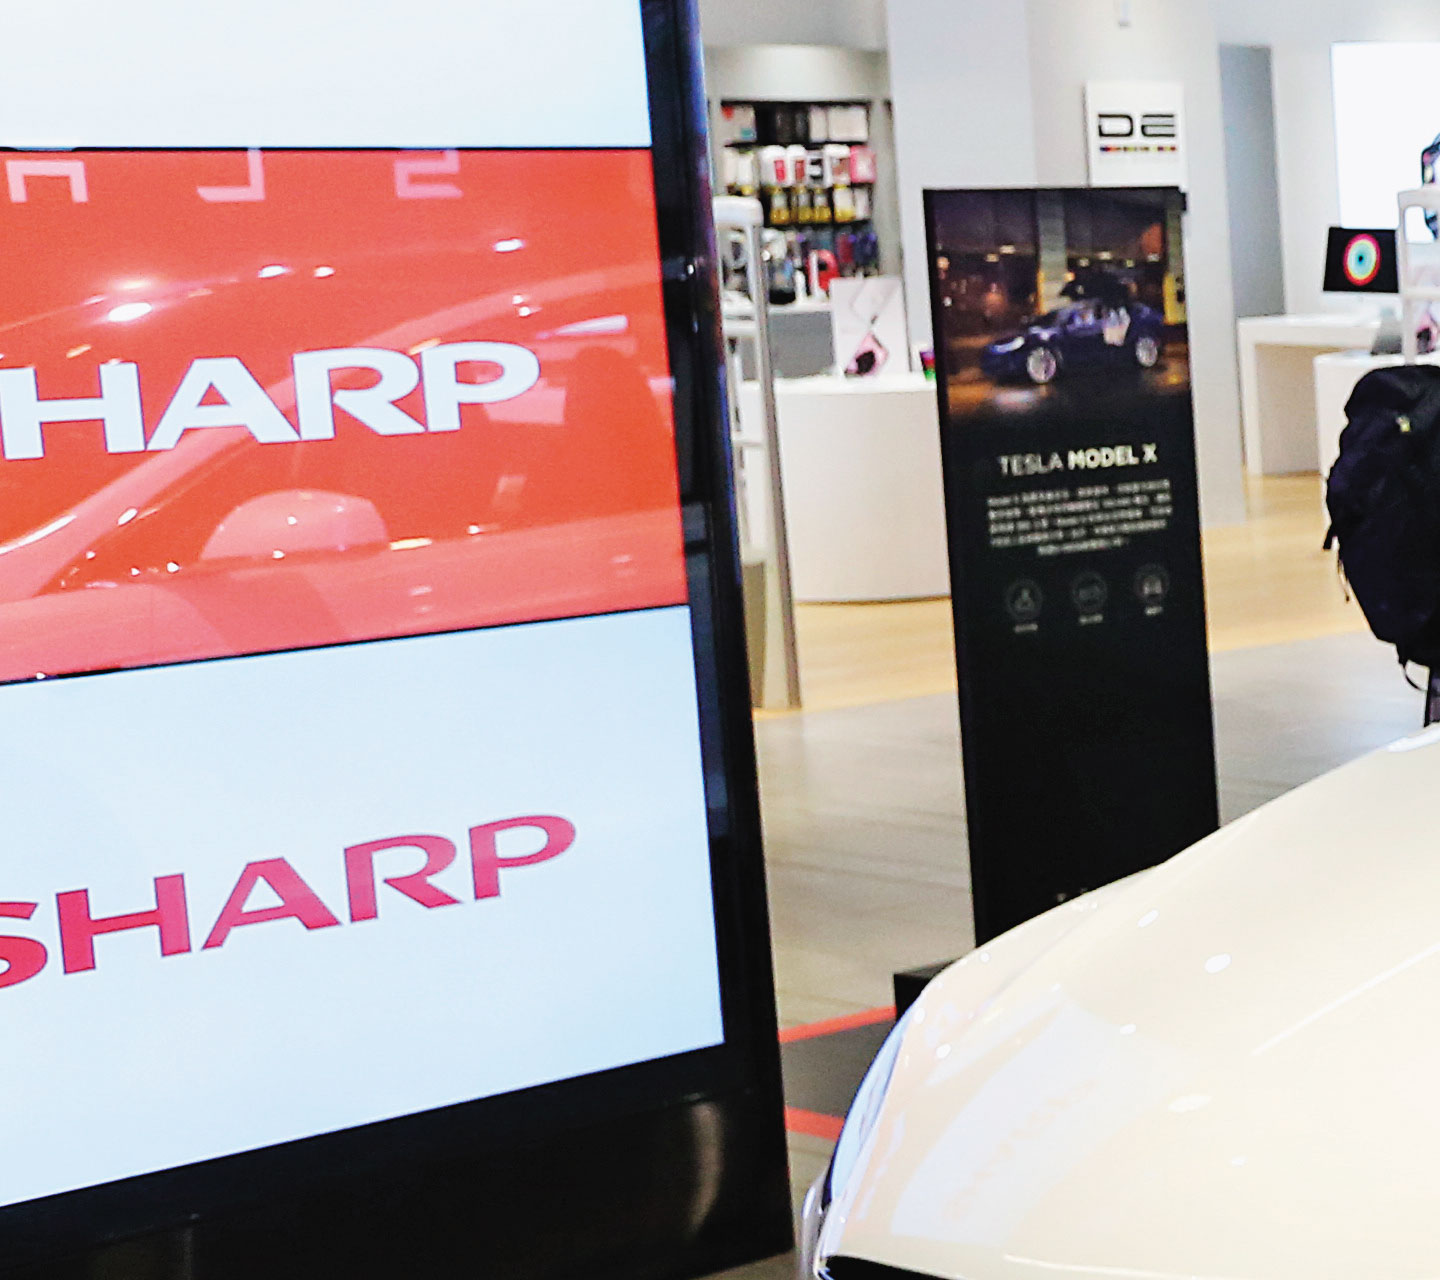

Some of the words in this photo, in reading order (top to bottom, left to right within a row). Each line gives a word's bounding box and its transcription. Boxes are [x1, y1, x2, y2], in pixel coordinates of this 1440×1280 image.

[1000, 452, 1063, 476] TESLA
[1067, 445, 1139, 470] MODEL
[1142, 443, 1157, 464] X
